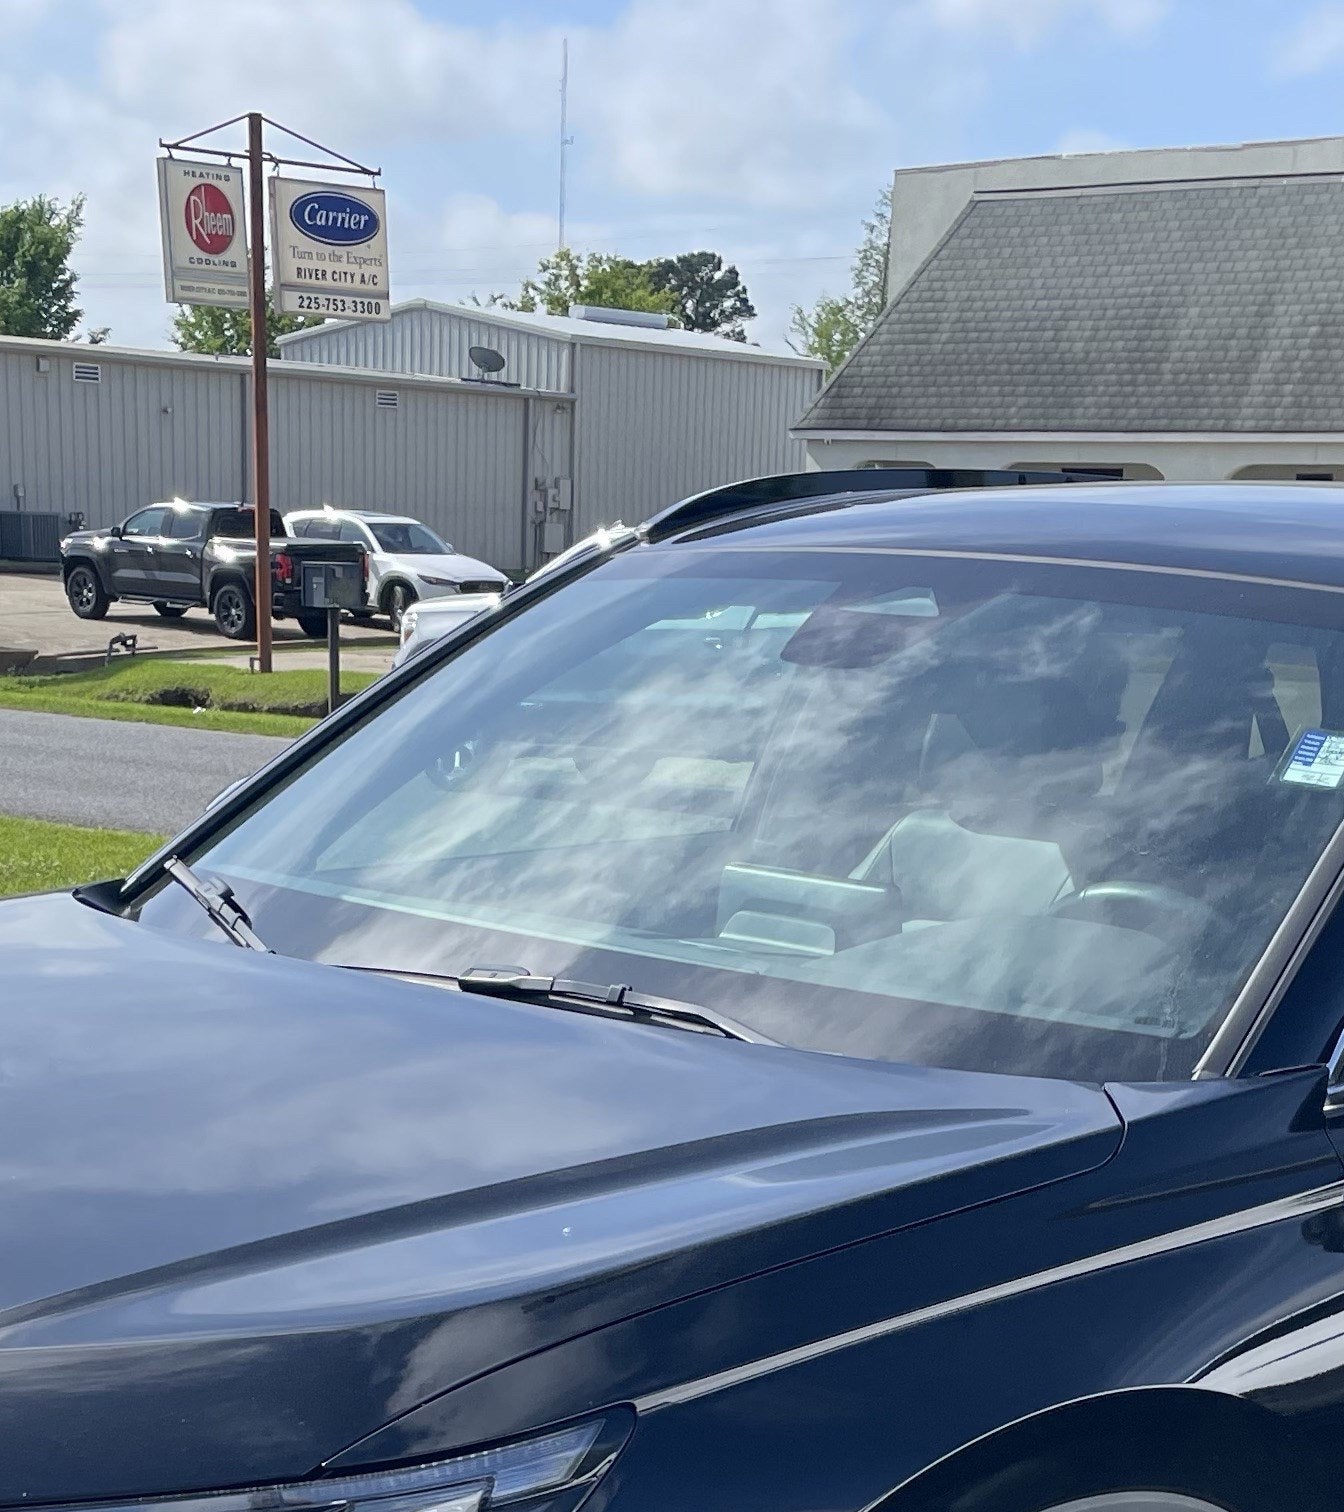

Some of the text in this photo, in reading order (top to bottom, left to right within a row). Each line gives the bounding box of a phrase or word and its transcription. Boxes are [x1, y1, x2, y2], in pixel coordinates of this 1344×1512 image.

[183, 170, 231, 182] HEATING
[189, 185, 233, 244] Rheem
[304, 203, 369, 230] Carrier
[188, 256, 237, 268] COOLING
[289, 245, 382, 269] Turn to the Experts
[296, 267, 379, 286] RIVER CITY A/C
[298, 295, 381, 315] 225-753-3300
